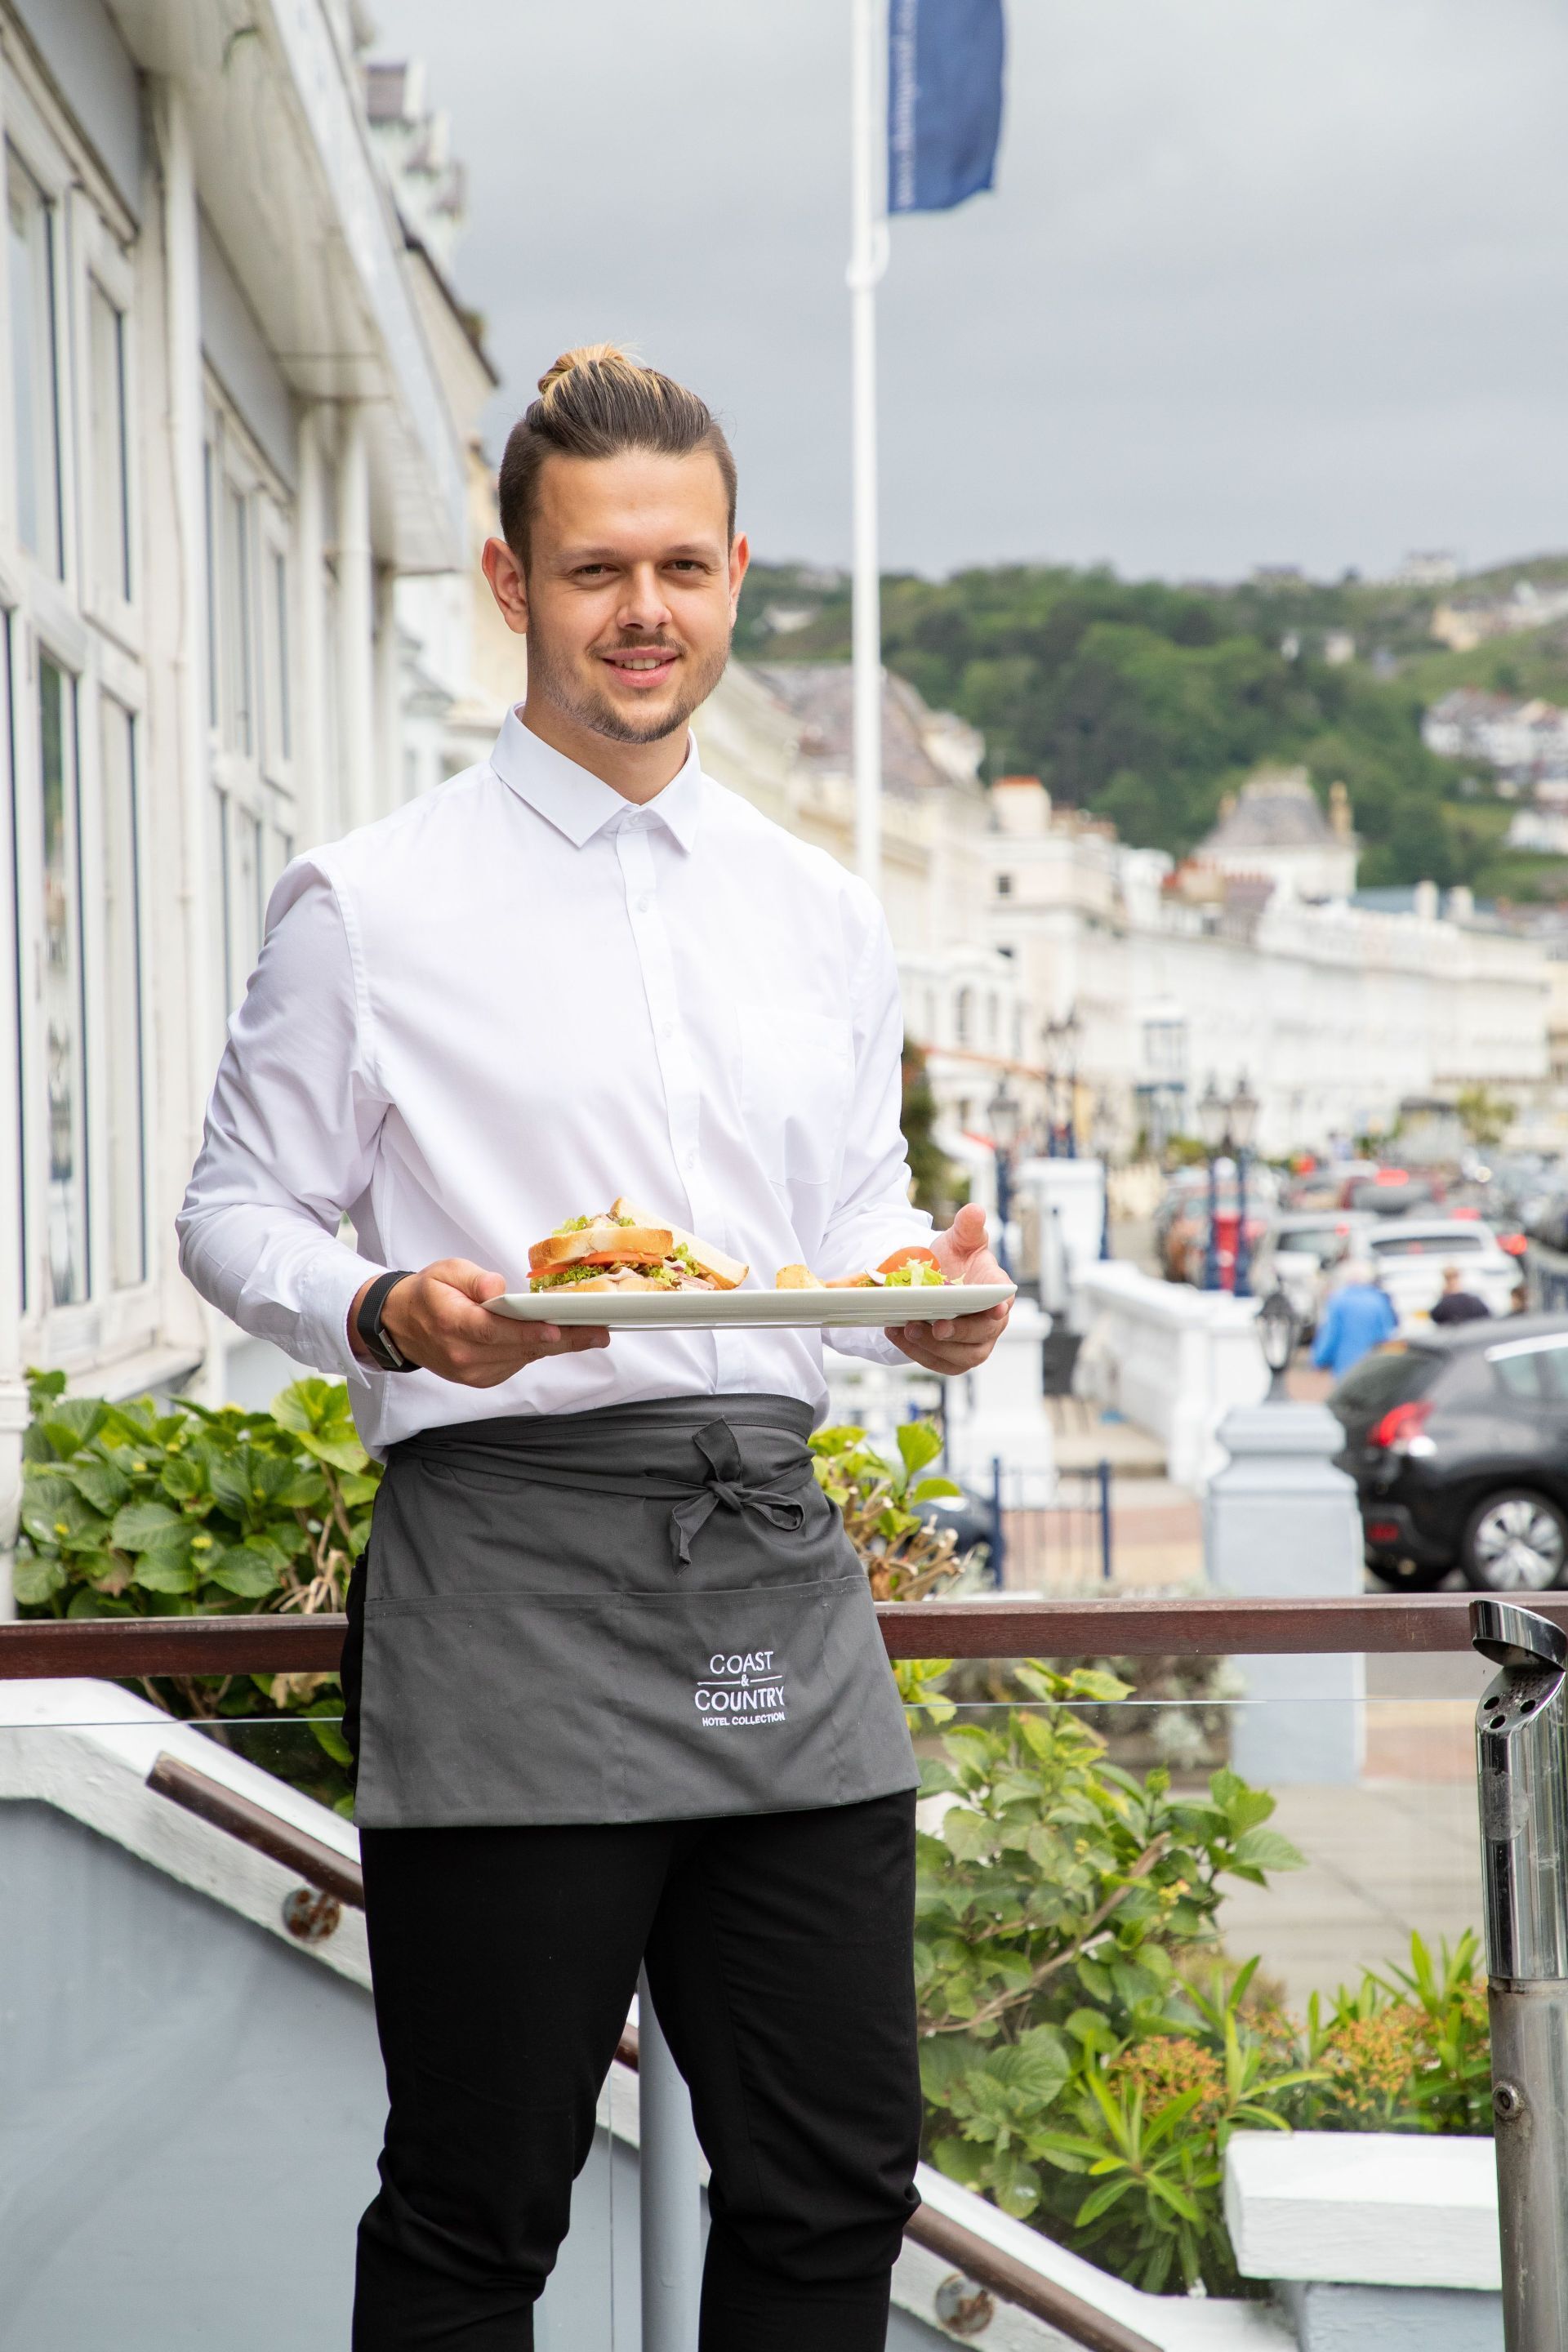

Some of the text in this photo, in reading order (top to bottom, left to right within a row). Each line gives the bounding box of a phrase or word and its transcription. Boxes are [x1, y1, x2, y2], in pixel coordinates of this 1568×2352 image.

[710, 1651, 773, 1674] COAST
[741, 1674, 750, 1686] &
[694, 1686, 785, 1712] COUNTRY
[702, 1712, 786, 1726] HOTEL COLLECTION
